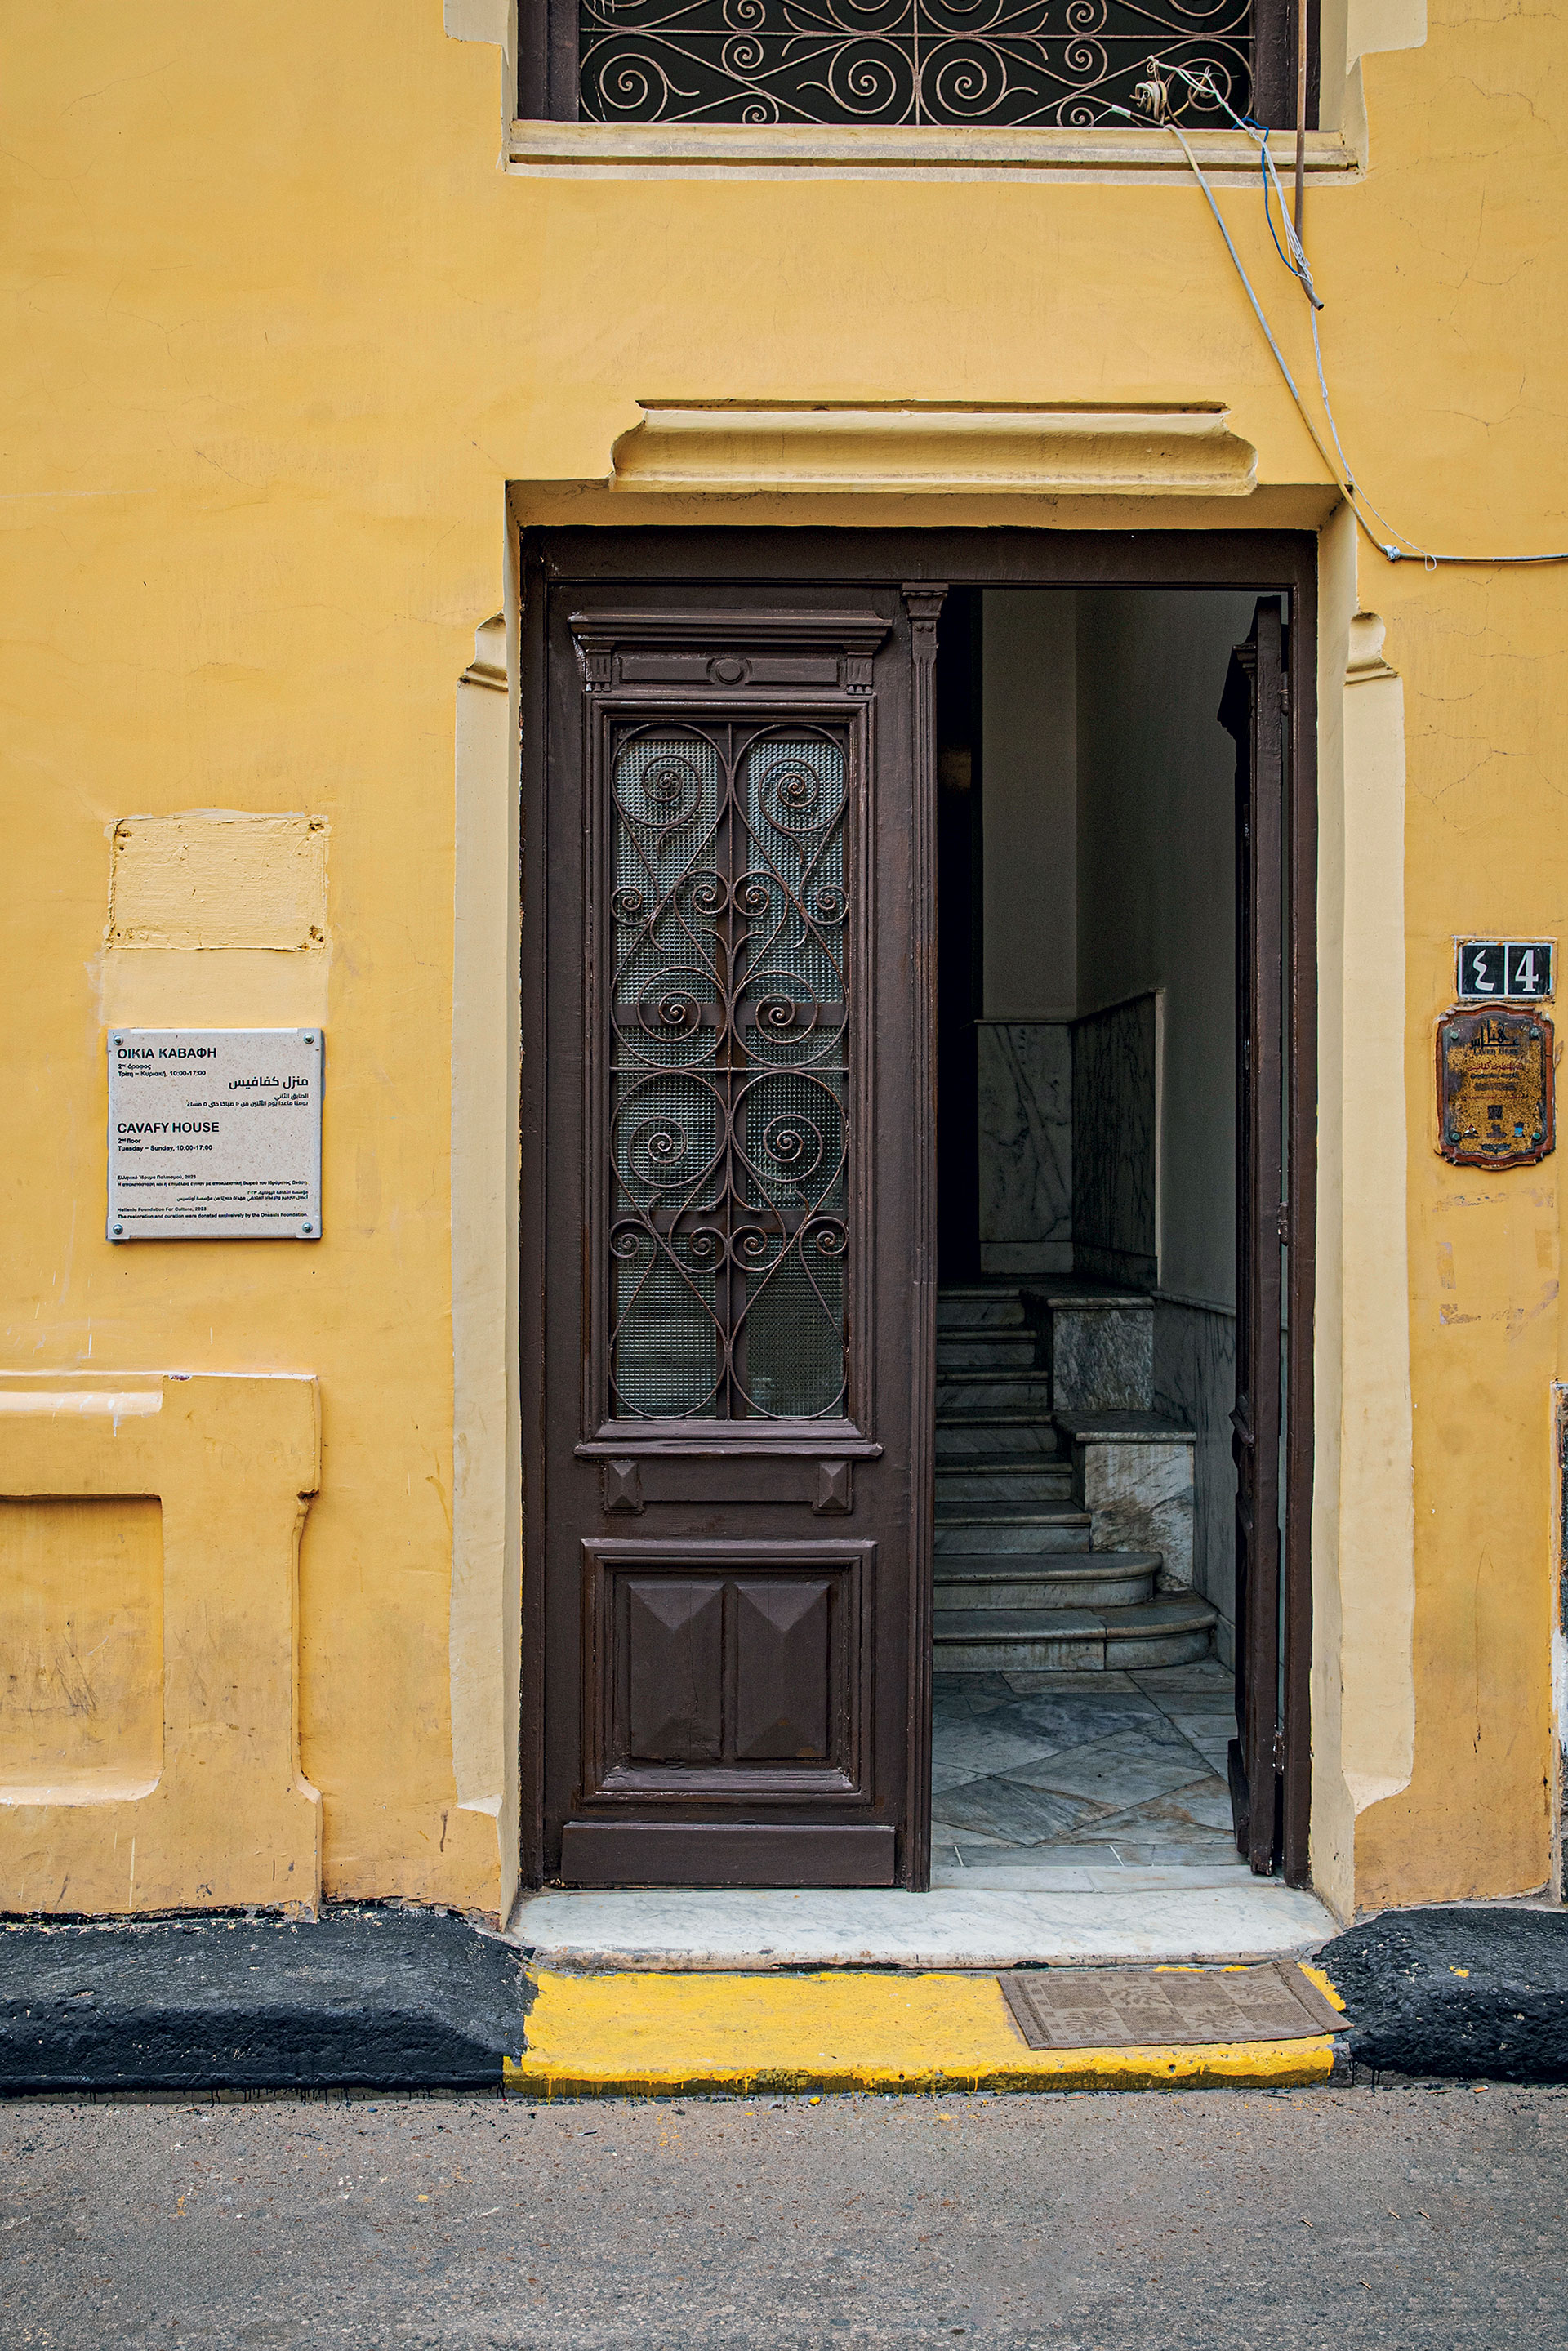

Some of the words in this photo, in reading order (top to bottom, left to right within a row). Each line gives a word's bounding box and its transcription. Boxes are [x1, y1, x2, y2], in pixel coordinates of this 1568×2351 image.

[1472, 948, 1494, 991] ٤
[1515, 949, 1539, 991] 4
[118, 1049, 154, 1058] ΟΙΚΙΑ
[159, 1048, 216, 1058] ΚΑΒΑΦΗ
[229, 1076, 279, 1089] كفافيس
[283, 1076, 309, 1088] منزل
[118, 1123, 170, 1133] CAVAFY
[172, 1122, 220, 1133] HOUSE
